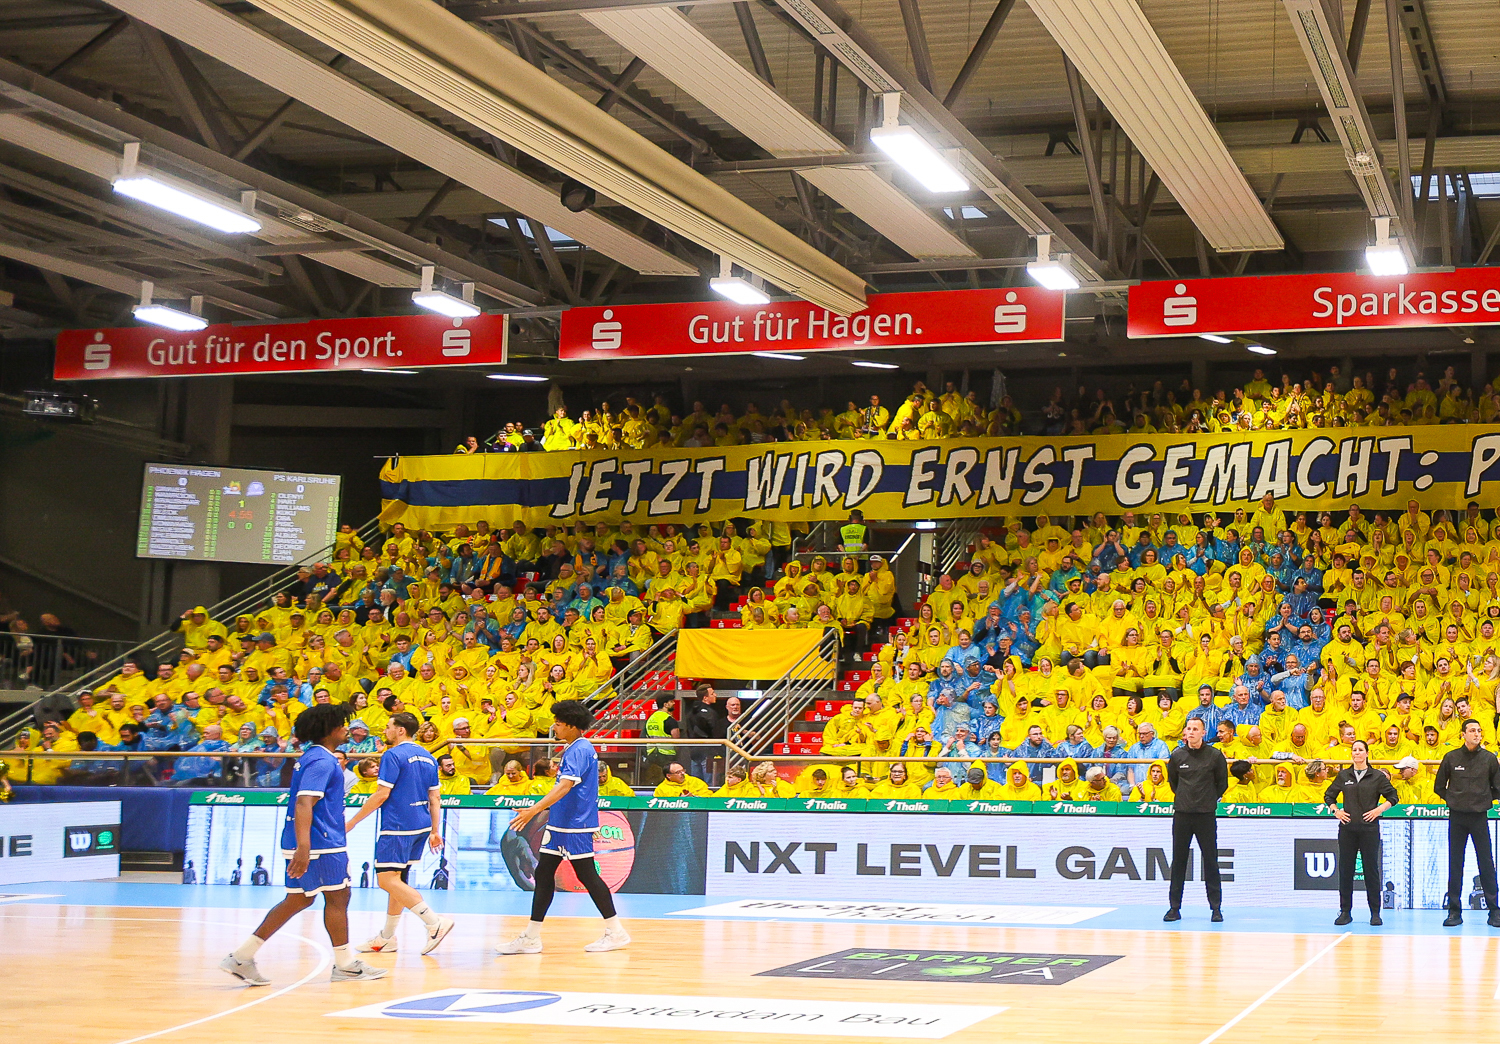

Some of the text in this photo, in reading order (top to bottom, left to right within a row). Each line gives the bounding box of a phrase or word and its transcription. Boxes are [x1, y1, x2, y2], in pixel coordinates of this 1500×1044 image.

[688, 310, 922, 344] Gut für Hagen.
[147, 331, 403, 366] Gut für den Sport.
[549, 453, 727, 518] JETZT
[744, 448, 885, 511] WIRD
[902, 443, 1095, 507] ERNST
[1113, 433, 1438, 508] GEMACHT:
[214, 794, 245, 804] Thalia
[440, 797, 460, 806] alia
[504, 798, 535, 807] Thalia
[658, 799, 689, 809] Thalia
[737, 799, 767, 810] Thalia
[816, 800, 847, 810] Thalia
[896, 801, 929, 811] Thalia
[979, 802, 1012, 812] Thalia
[1063, 803, 1096, 813] Thalia
[1148, 804, 1175, 814] Thal
[1236, 805, 1271, 815] Thalia
[725, 841, 1235, 882] NXT LEVEL GAME
[740, 902, 936, 912] theater
[826, 909, 995, 921] hagen
[843, 952, 1091, 966] BARMER
[567, 1003, 941, 1026] Rotterdam Bau
